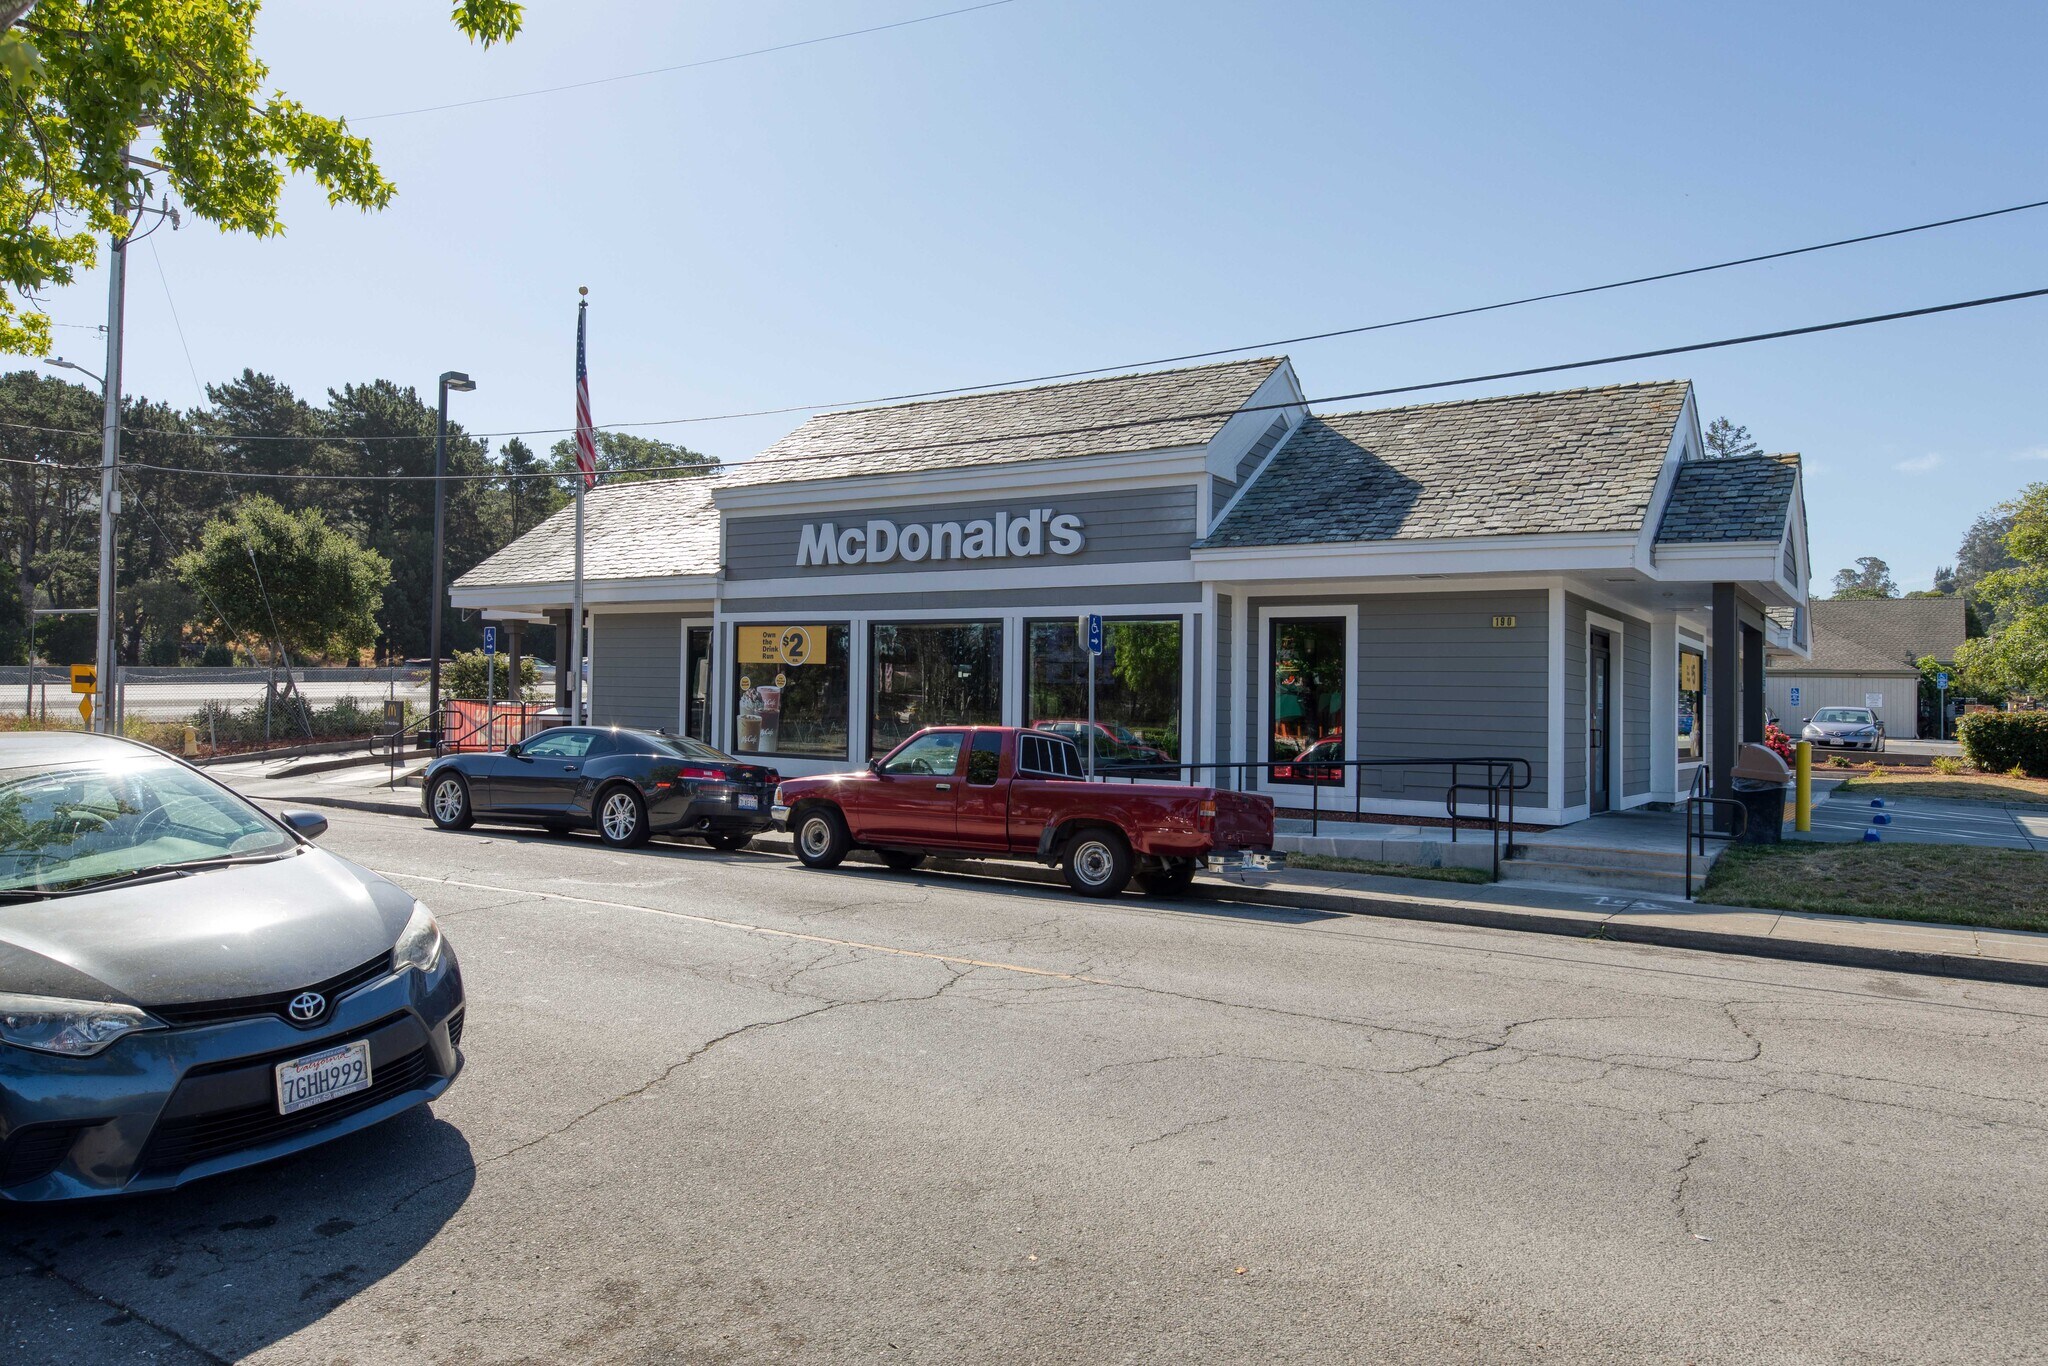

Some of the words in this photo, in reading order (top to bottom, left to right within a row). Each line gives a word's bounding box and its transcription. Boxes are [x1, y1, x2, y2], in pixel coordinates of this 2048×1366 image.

[796, 508, 1085, 566] McDonald's
[1495, 616, 1512, 627] 190
[782, 633, 803, 656] $2
[295, 1052, 351, 1074] California
[284, 1060, 363, 1103] 7GHH999
